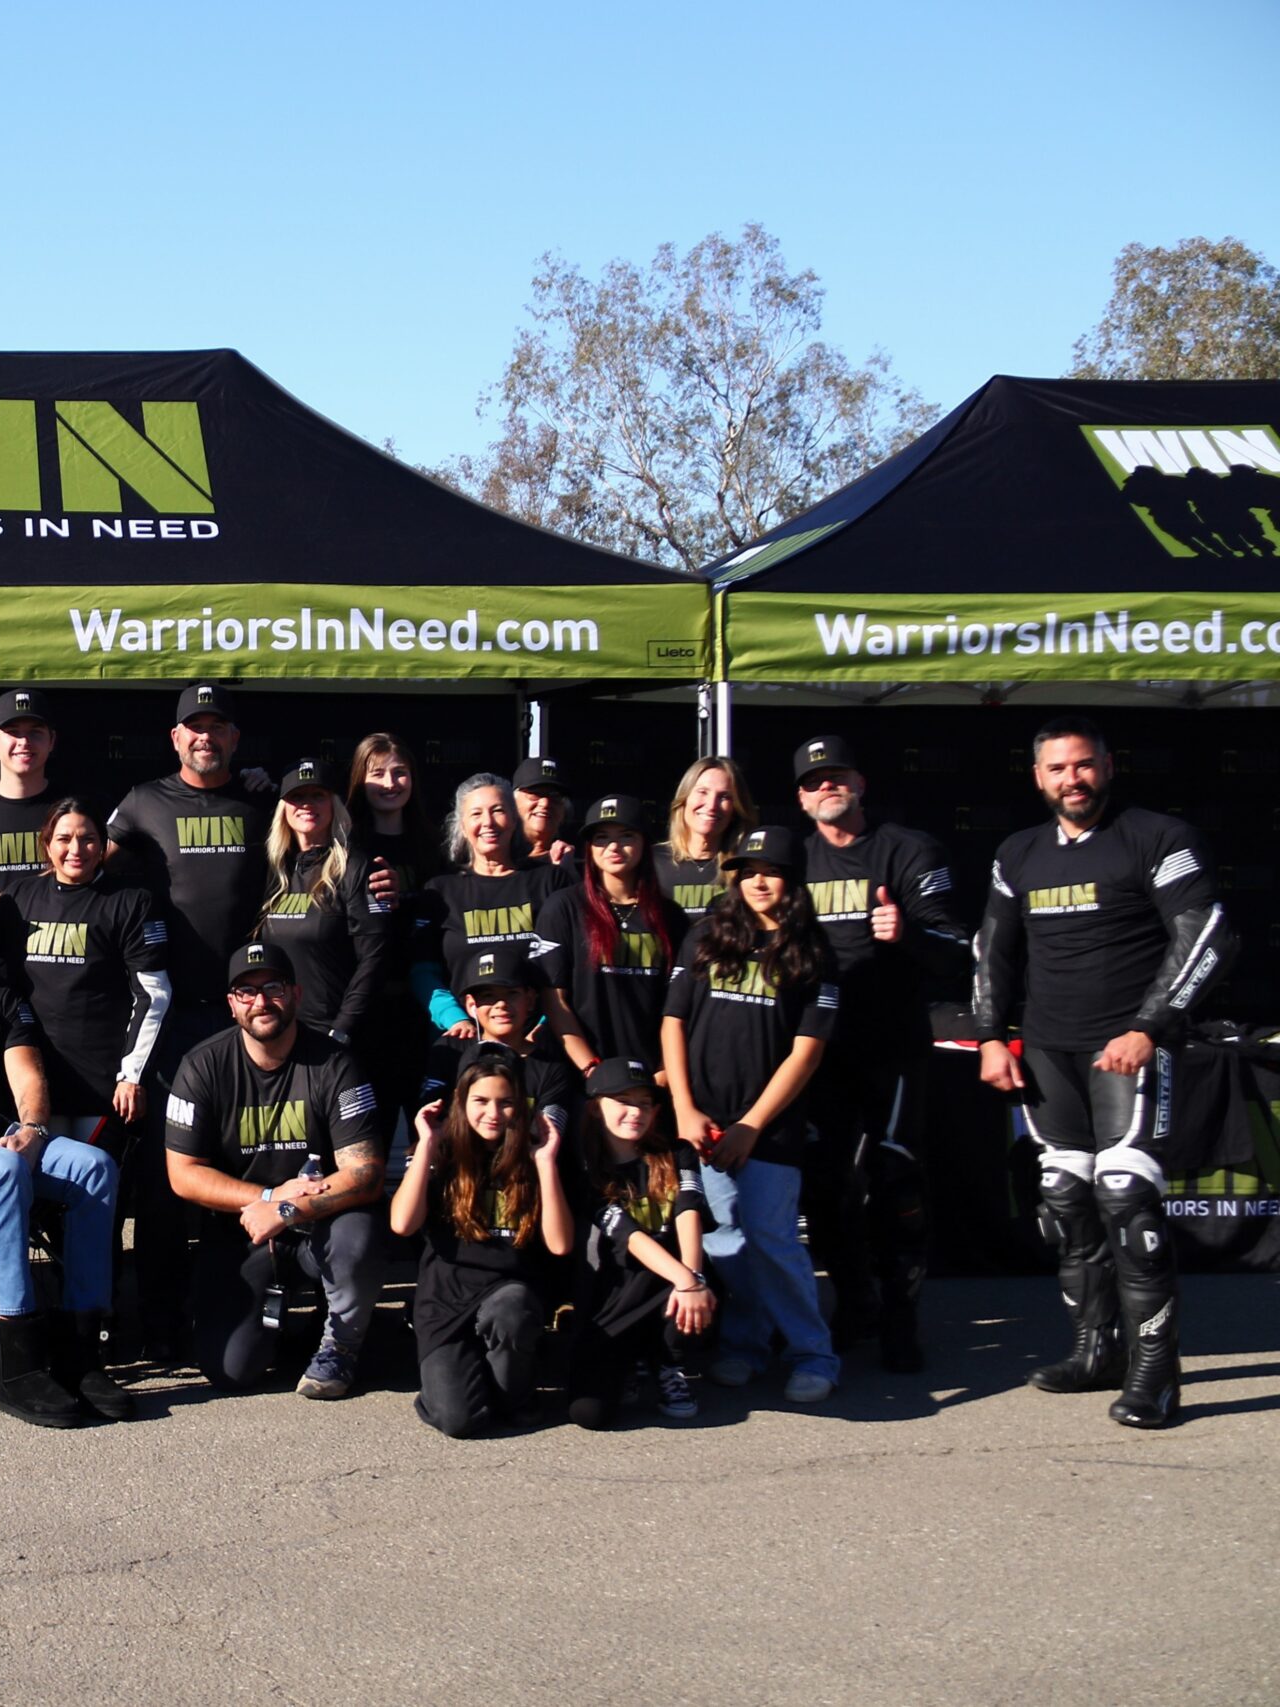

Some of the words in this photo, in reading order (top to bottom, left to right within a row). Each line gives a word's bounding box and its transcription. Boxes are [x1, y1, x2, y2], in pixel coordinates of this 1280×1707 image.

[25, 518, 70, 538] IN
[93, 519, 219, 539] NEED
[69, 607, 599, 652] WarriorsInNeed.com
[176, 816, 245, 847] WIN
[228, 845, 246, 853] NEED
[1028, 882, 1096, 908] WIN
[464, 902, 534, 937] WIN
[27, 921, 88, 957] WIN
[467, 936, 505, 945] WARRIORS
[27, 954, 56, 963] WARRIORS
[67, 956, 85, 964] NEED
[1173, 951, 1216, 1006] CORTECH
[285, 1142, 307, 1150] NEED
[1217, 1200, 1237, 1216] IN
[1245, 1200, 1280, 1216] NEE
